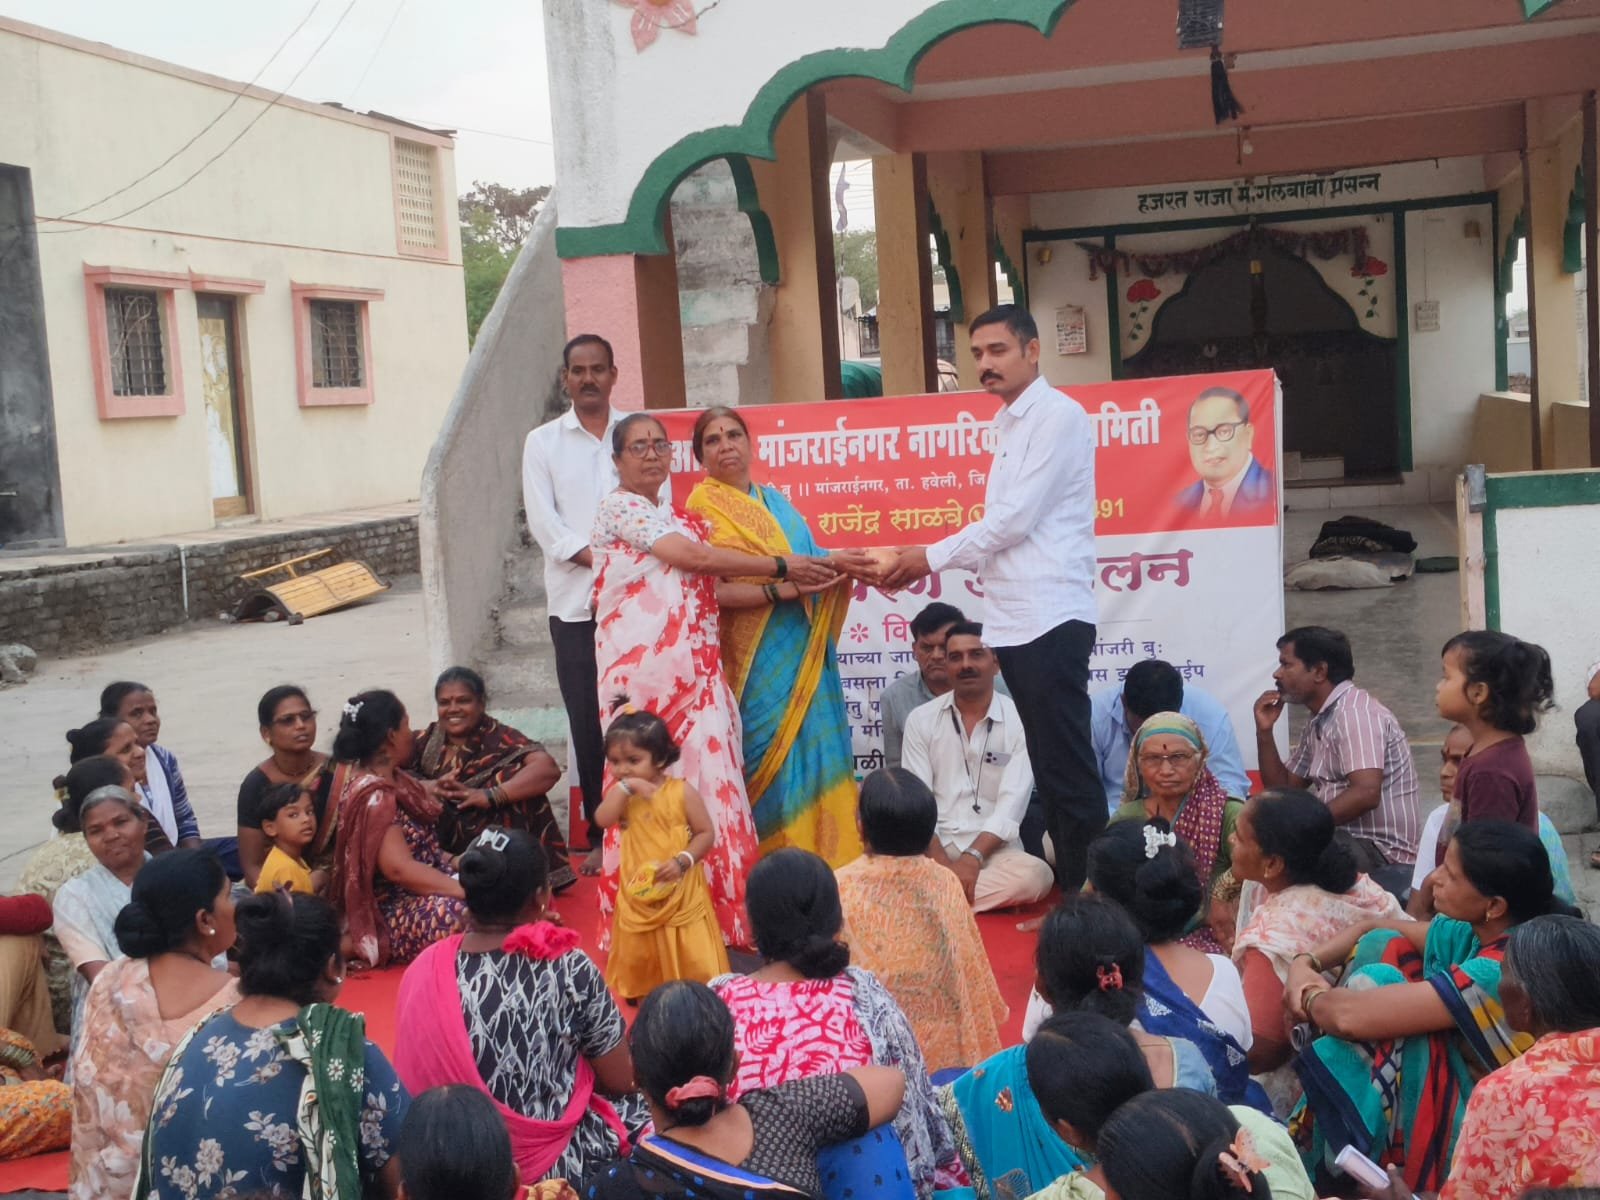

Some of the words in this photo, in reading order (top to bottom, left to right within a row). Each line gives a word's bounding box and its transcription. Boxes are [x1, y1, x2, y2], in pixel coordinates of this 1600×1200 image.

[1137, 191, 1188, 213] हजरत
[1194, 188, 1232, 207] राजा
[1330, 173, 1381, 198] प्रसन्न
[757, 416, 901, 468] मांजराईनगर
[817, 504, 881, 535] राजेंद्र
[889, 499, 964, 531] साळवे
